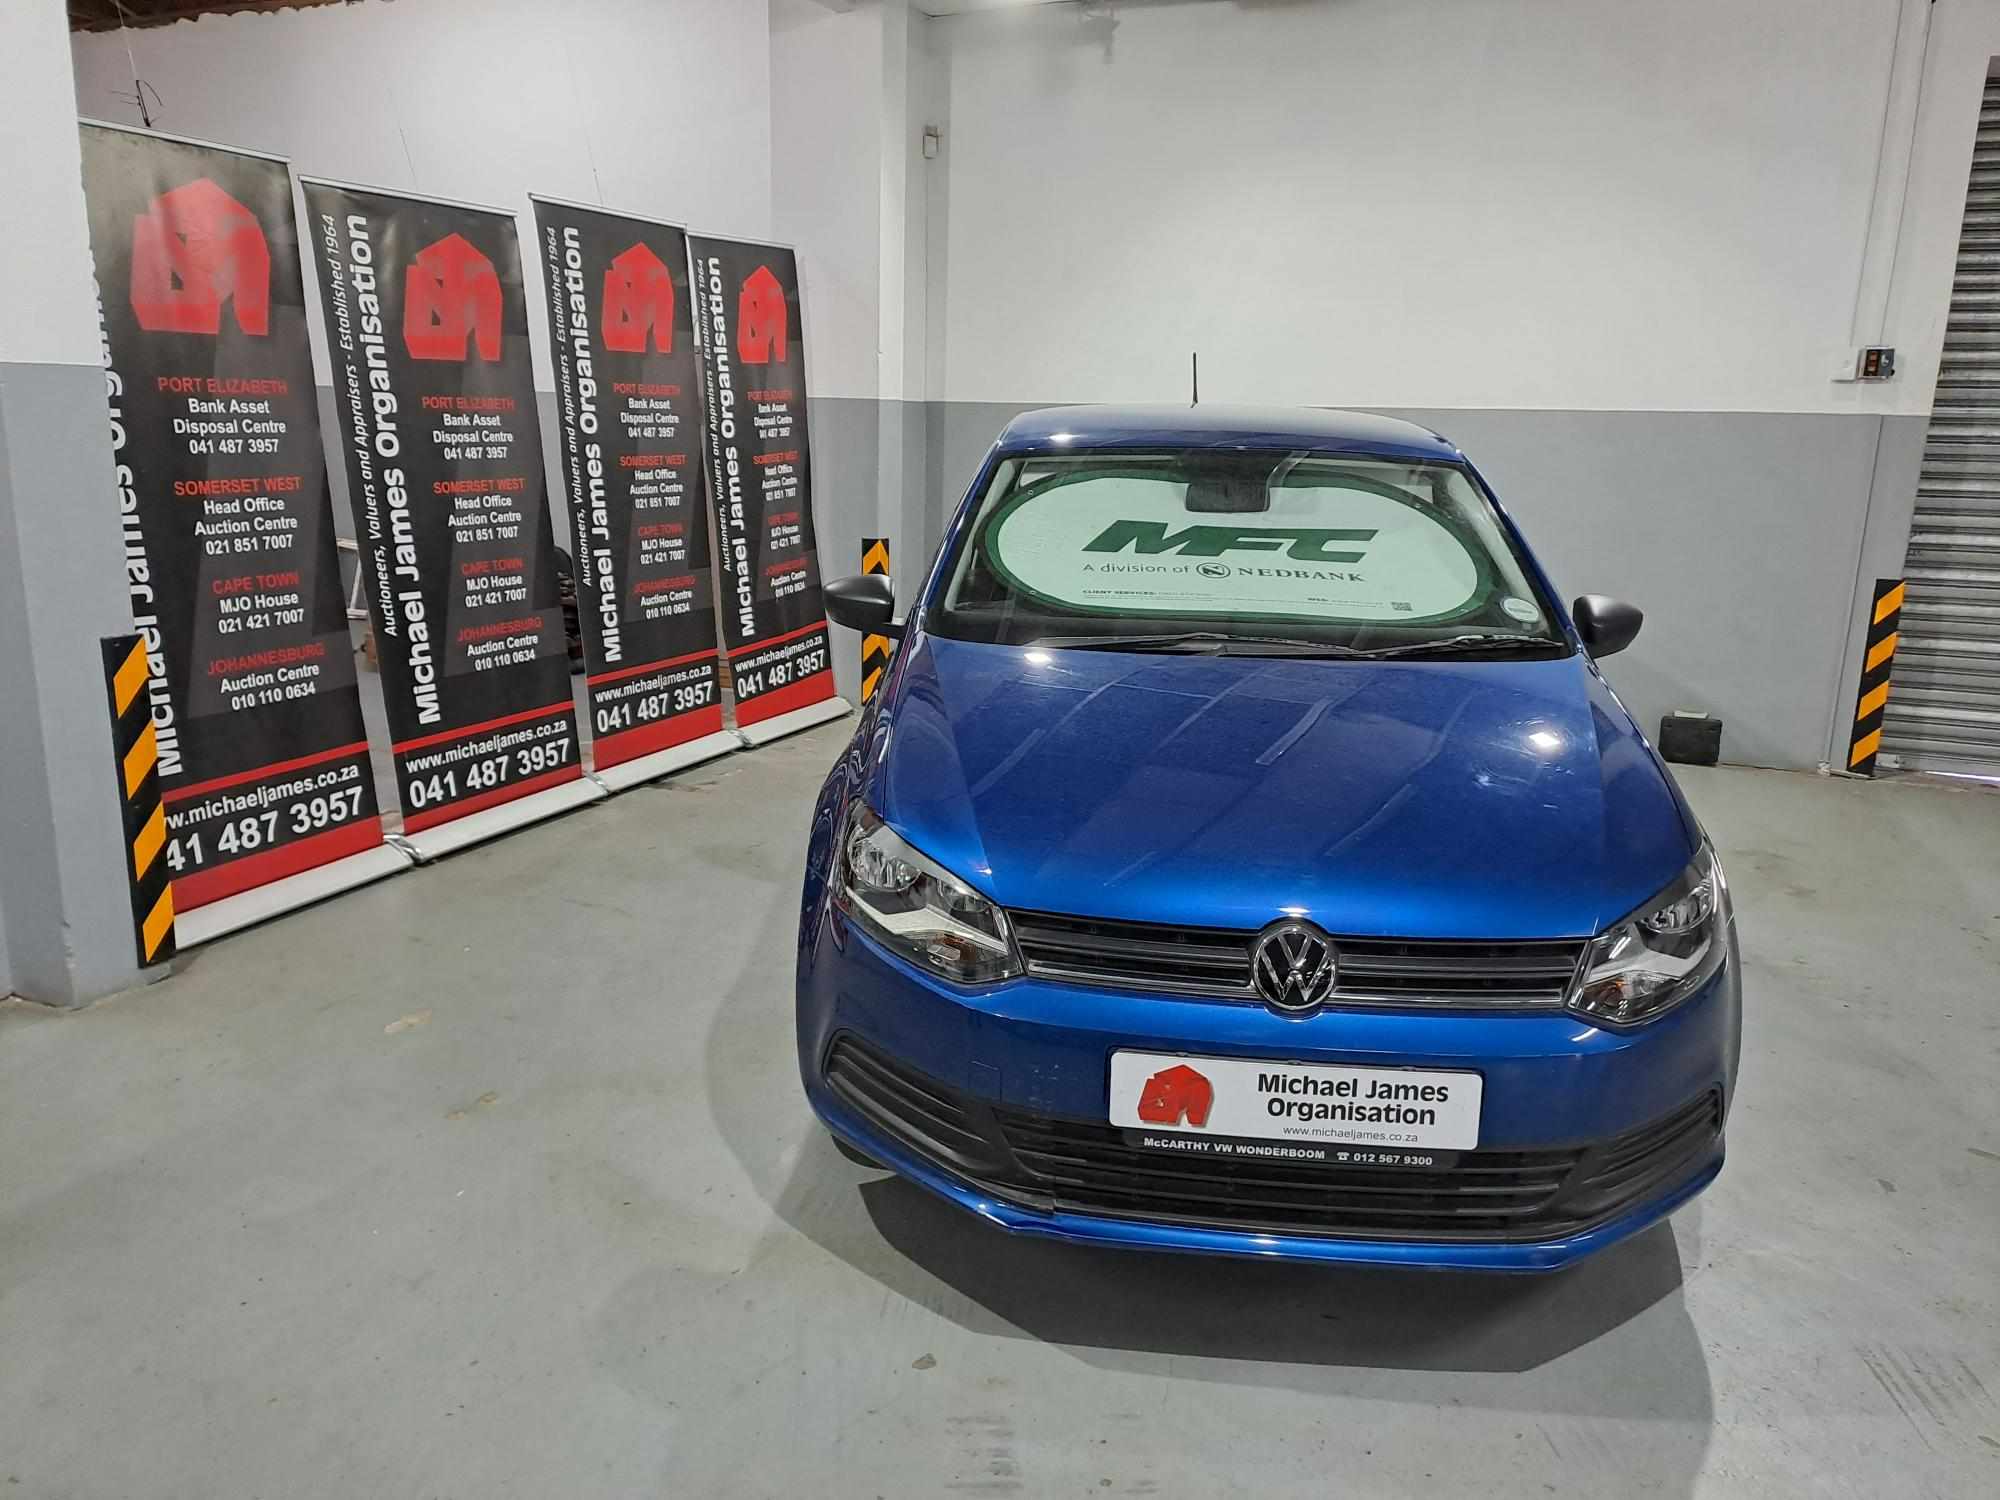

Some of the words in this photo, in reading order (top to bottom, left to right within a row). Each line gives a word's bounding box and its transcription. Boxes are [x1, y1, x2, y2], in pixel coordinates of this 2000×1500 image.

[321, 214, 339, 254] 1964
[328, 258, 353, 350] Established
[347, 215, 400, 457] Organisation
[563, 227, 598, 434] Organisation
[708, 257, 735, 439] Organisation
[158, 377, 201, 391] PORT
[207, 378, 288, 393] ELIZABETH
[188, 398, 226, 413] Bank
[229, 400, 270, 413] Asset
[346, 364, 369, 447] Appraisers
[422, 396, 454, 408] PORT
[628, 398, 647, 409] Bank
[173, 419, 238, 436] Disposal
[242, 420, 286, 433] Centre
[443, 413, 471, 426] Bank
[472, 414, 501, 426] Asset
[620, 412, 653, 425] Disposal
[189, 440, 214, 454] 041
[219, 439, 243, 453] 487
[248, 439, 279, 453] 3957
[432, 430, 479, 445] Disposal
[482, 430, 513, 442] Centre
[565, 427, 577, 452] and
[356, 450, 372, 479] and
[444, 447, 462, 460] 041
[465, 447, 483, 459] 487
[486, 447, 508, 458] 3957
[174, 479, 260, 495] SOMERSET
[264, 476, 301, 491] WEST
[585, 443, 610, 541] James
[630, 485, 658, 495] Auction
[725, 446, 744, 531] James
[203, 499, 240, 514] Head
[244, 497, 285, 512] Office
[364, 484, 382, 539] Valuers
[454, 496, 480, 510] Head
[482, 495, 512, 507] Office
[194, 520, 250, 536] Auction
[253, 516, 297, 531] Centre
[383, 468, 420, 582] James
[448, 513, 487, 527] Auction
[489, 511, 522, 524] Centre
[205, 540, 230, 555] 021
[234, 537, 258, 553] 851
[262, 534, 293, 549] 7007
[456, 529, 473, 543] 021
[475, 527, 493, 540] 851
[1081, 519, 1378, 563] MFC
[212, 577, 252, 594] CAPE
[256, 571, 299, 588] TOWN
[466, 578, 489, 591] MJO
[491, 575, 523, 588] House
[1101, 563, 1167, 572] division
[1173, 565, 1188, 573] of
[1238, 567, 1365, 582] NEDBANK
[374, 545, 397, 636] Auctioneers,
[465, 595, 482, 608] 021
[485, 592, 502, 604] 421
[504, 588, 527, 602] 7007
[732, 537, 755, 637] Michael
[219, 597, 251, 614] MJO
[254, 593, 299, 609] House
[593, 548, 622, 662] Michael
[218, 618, 242, 634] 021
[246, 614, 270, 629] 421
[274, 608, 305, 626] 7007
[399, 591, 441, 724] Michael
[467, 641, 505, 657] Auction
[507, 635, 538, 649] Centre
[475, 658, 492, 671] 010
[494, 653, 511, 667] 110
[513, 648, 536, 663] 0634
[220, 673, 274, 693] Auction
[277, 664, 320, 681] Centre
[595, 665, 711, 702] www.michaeljames.co.za
[737, 672, 763, 698] 041
[768, 661, 793, 686] 487
[796, 649, 824, 676] 3957
[231, 693, 256, 711] 010
[258, 688, 282, 704] 110
[286, 681, 316, 699] 0634
[596, 702, 631, 733] 041
[637, 692, 668, 720] 487
[673, 680, 713, 711] 3957
[405, 719, 568, 774] www.michaeljames.co.za
[409, 770, 457, 808] 041
[466, 754, 509, 790] 487
[516, 738, 570, 775] 3957
[166, 764, 359, 830] w.michaeljames.co.za
[166, 833, 203, 871] 41
[218, 811, 279, 854] 487
[289, 786, 363, 833] 3957
[1258, 1073, 1357, 1097] Michael
[1366, 1080, 1449, 1102] James
[1267, 1098, 1435, 1125] Organisation
[1283, 1127, 1418, 1142] www.michaeljames.co.za
[1144, 1137, 1210, 1151] McCARTHY
[1213, 1143, 1233, 1152] VW
[1236, 1145, 1325, 1159] WONDERBOOM
[1354, 1152, 1375, 1163] 012
[1378, 1154, 1400, 1164] 567
[1404, 1156, 1433, 1166] 9300
